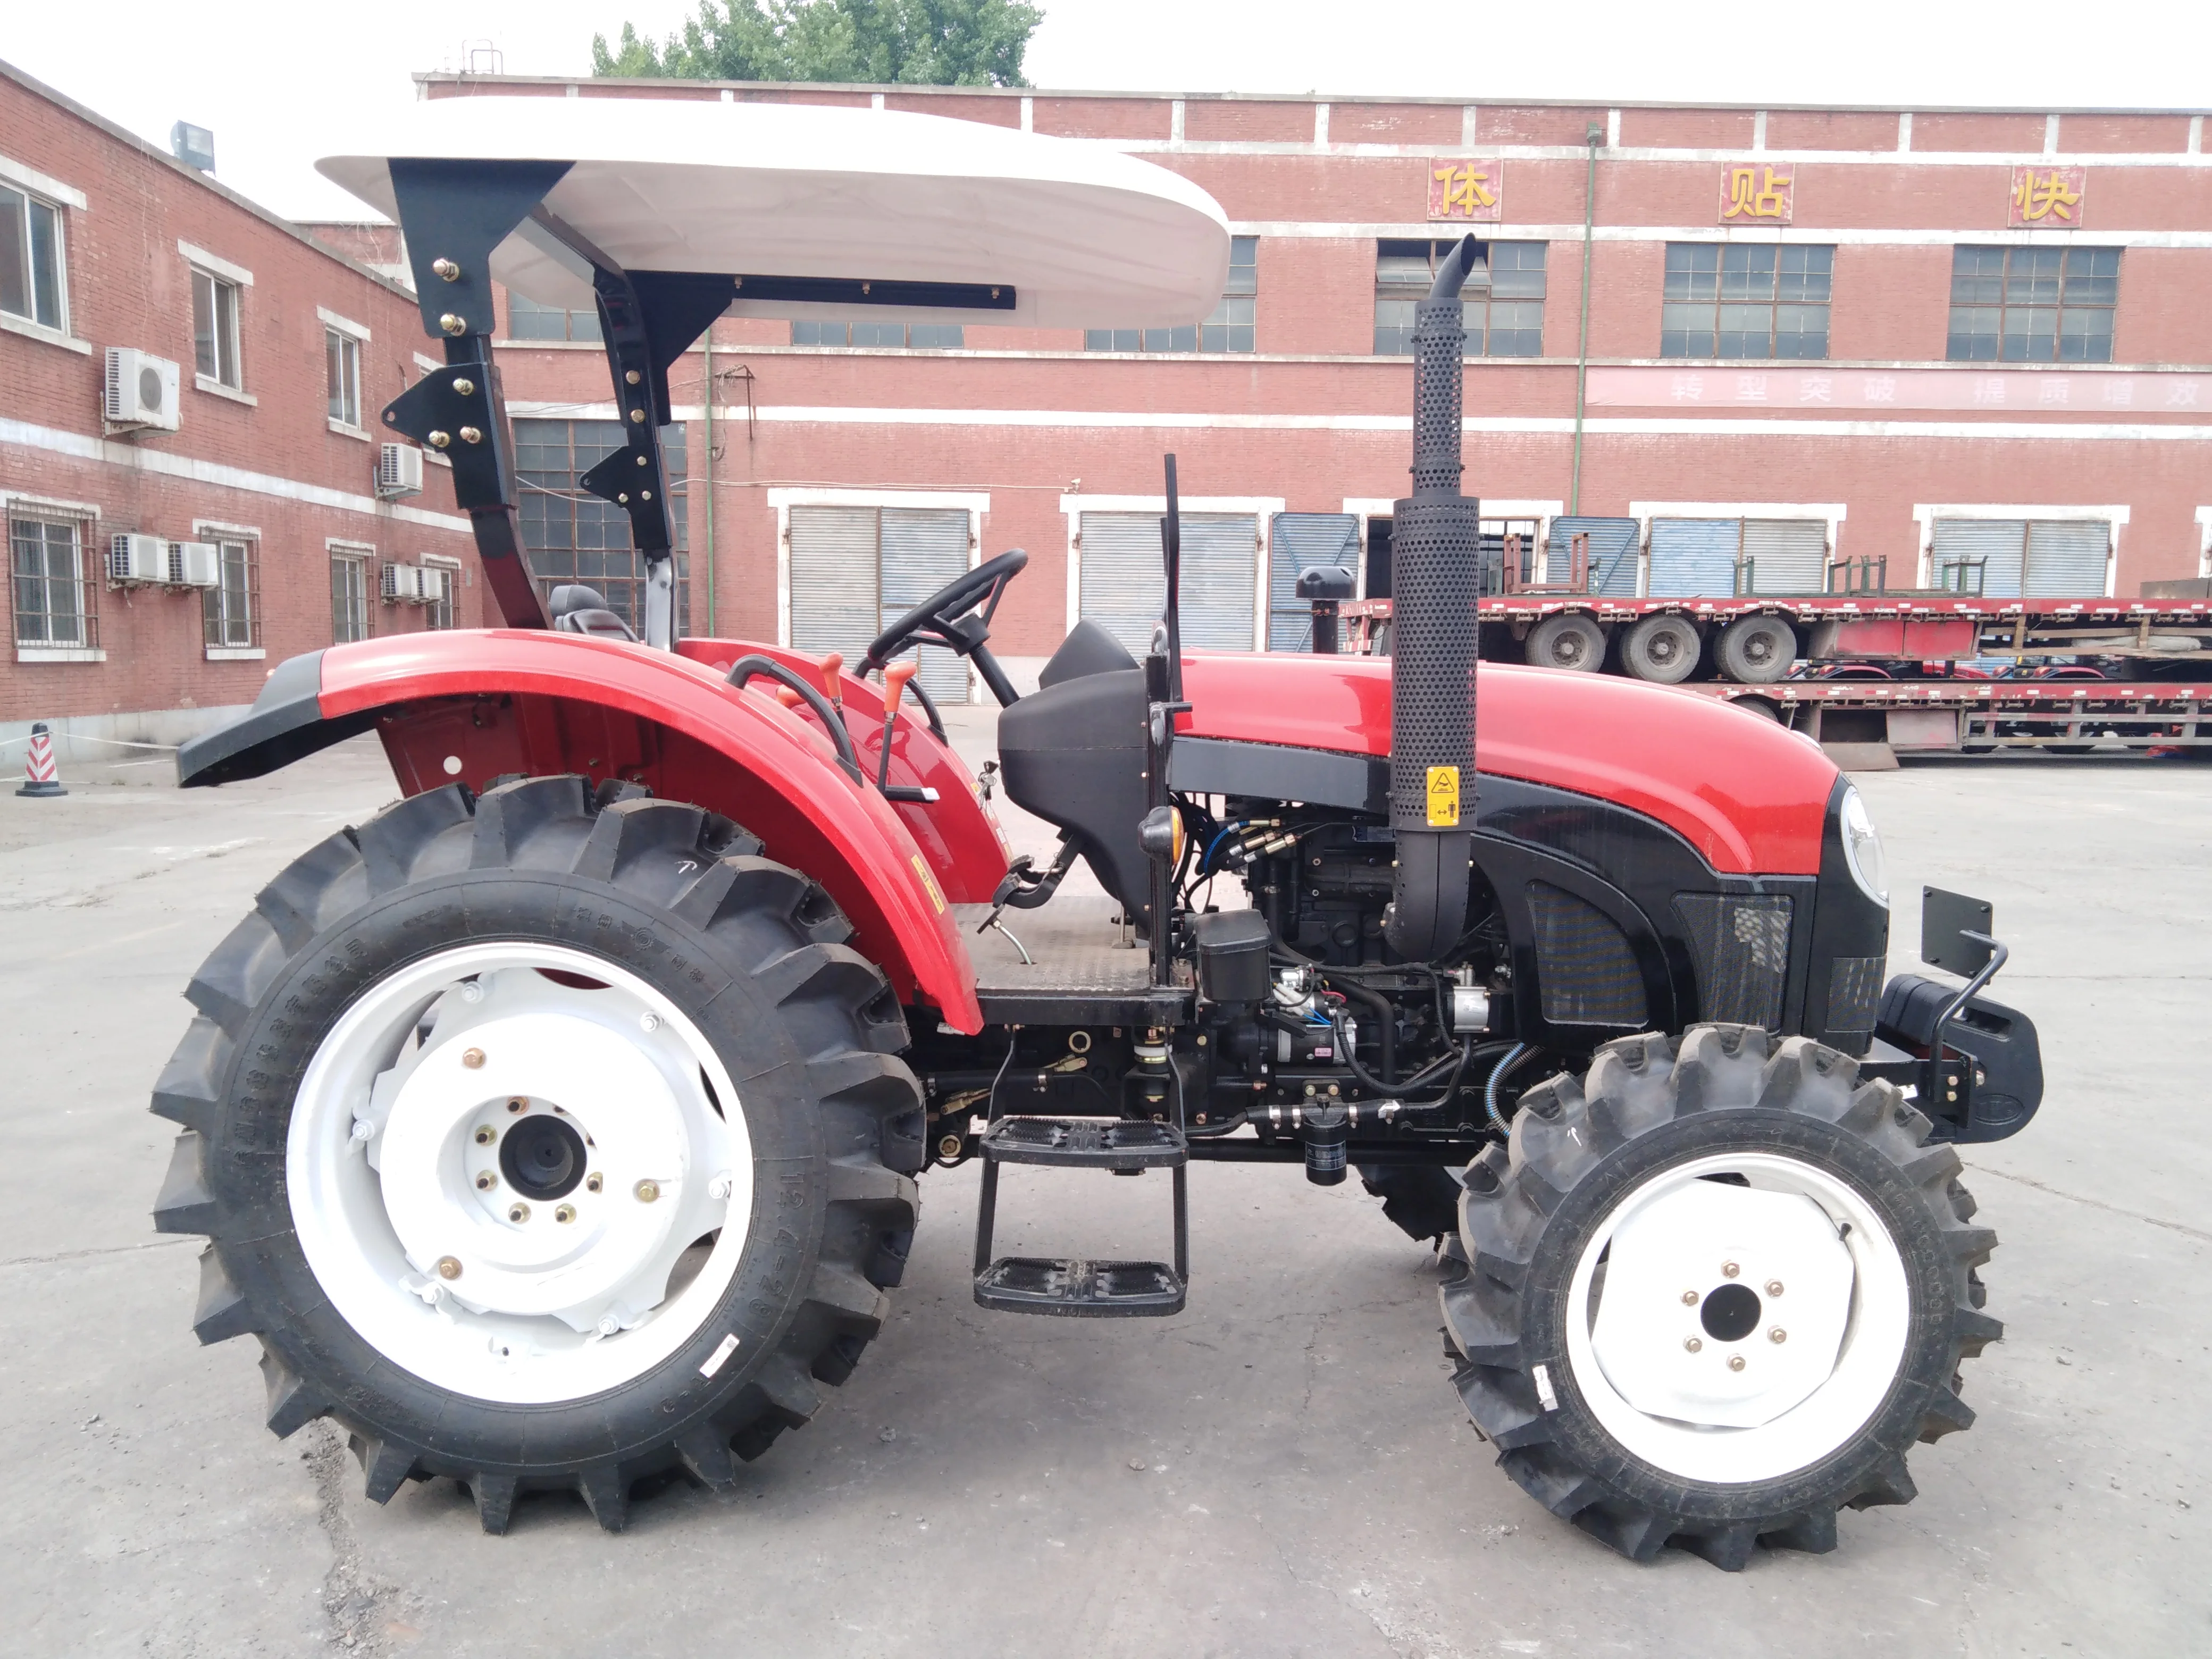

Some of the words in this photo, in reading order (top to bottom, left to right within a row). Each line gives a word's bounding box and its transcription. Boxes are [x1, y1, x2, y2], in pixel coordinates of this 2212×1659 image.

[1434, 163, 1496, 215] 体
[1724, 167, 1790, 217] 贴
[2016, 171, 2081, 221] 快
[1671, 374, 1897, 402] 转型突破
[1973, 378, 2200, 406] 提质增效
[748, 1171, 805, 1321] 12.4-28
